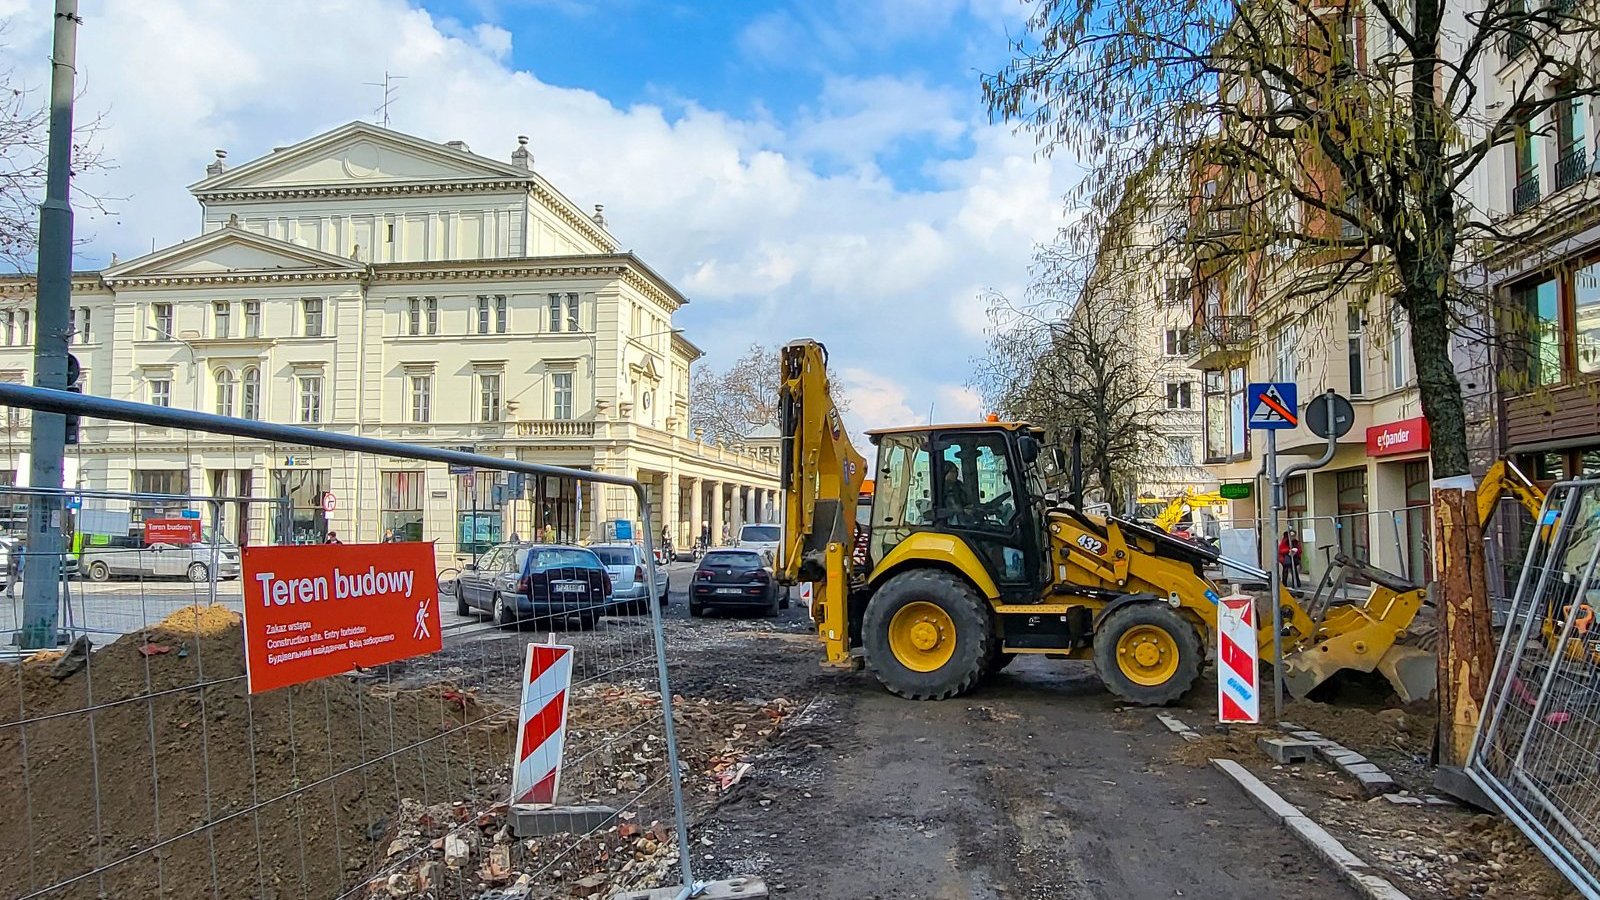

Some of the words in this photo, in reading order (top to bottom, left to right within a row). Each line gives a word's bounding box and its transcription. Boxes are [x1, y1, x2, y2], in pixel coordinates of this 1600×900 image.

[1377, 428, 1409, 449] expander
[1077, 534, 1102, 554] 432
[255, 572, 328, 607] Teren
[334, 565, 414, 598] budowy
[266, 624, 287, 635] Zakaz
[267, 636, 309, 649] Construction
[310, 633, 323, 642] site.
[324, 630, 339, 640] Entry
[340, 626, 366, 636] forbidden
